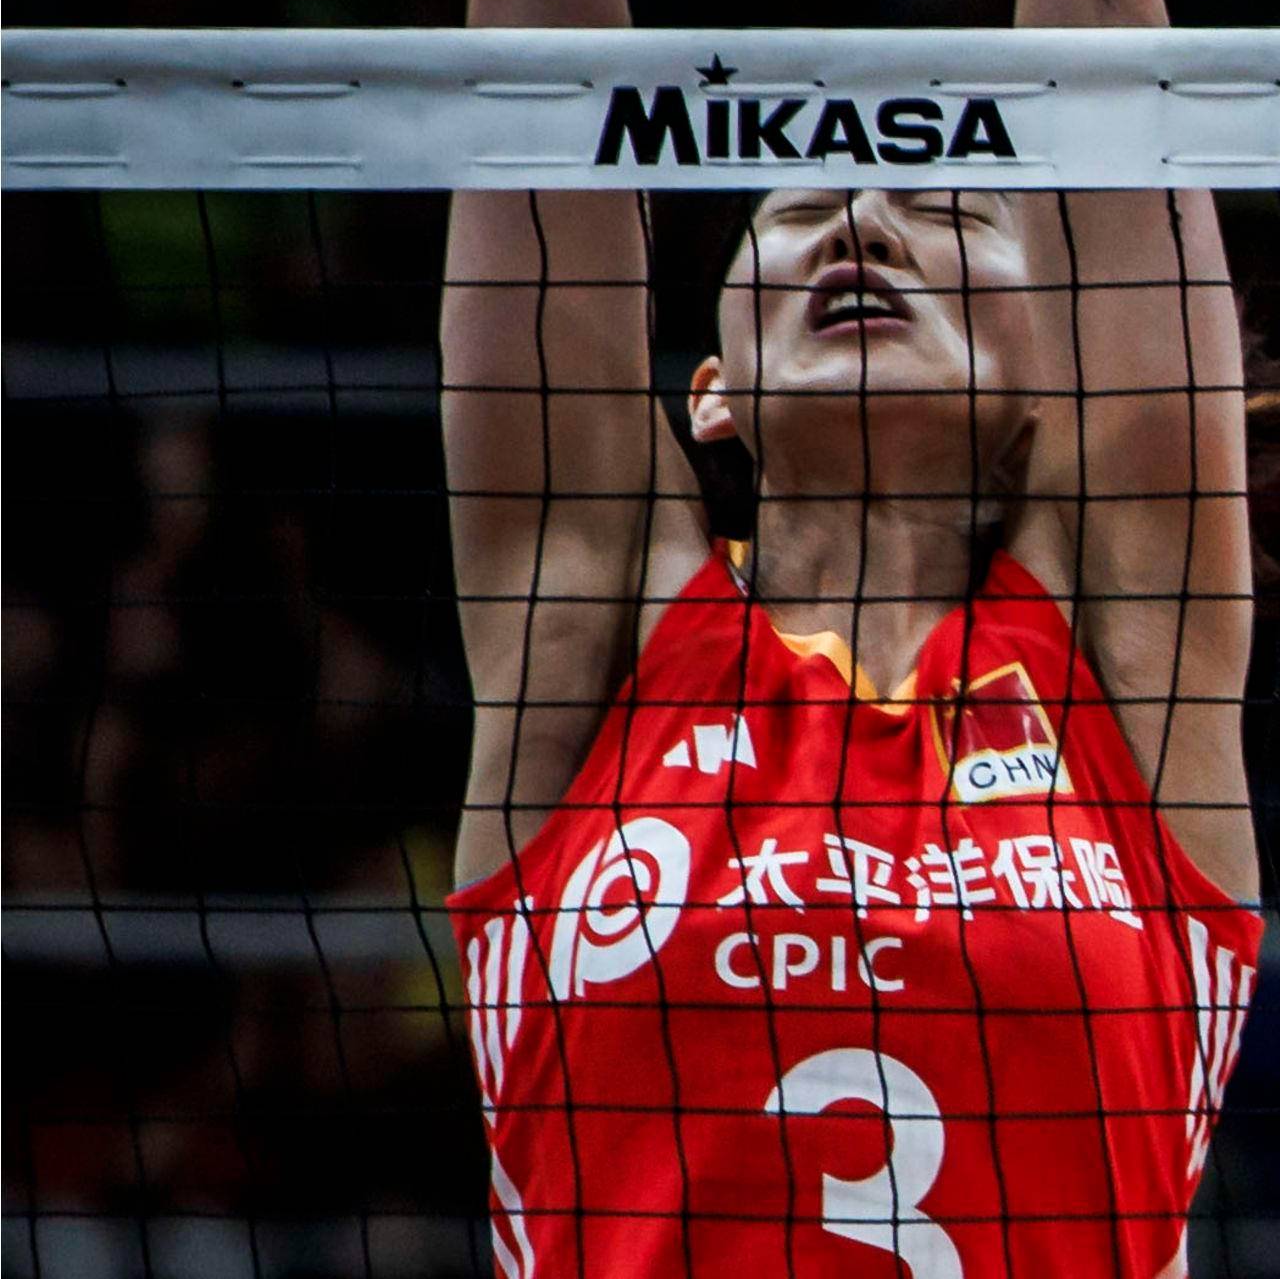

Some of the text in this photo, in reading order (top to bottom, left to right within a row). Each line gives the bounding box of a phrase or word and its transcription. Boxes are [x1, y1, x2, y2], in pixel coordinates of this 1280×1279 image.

[595, 53, 1017, 166] MIKASA
[968, 753, 1057, 790] CHN
[716, 832, 1144, 931] 太平洋保险
[715, 932, 905, 993] CPIC
[763, 1047, 965, 1279] 3
